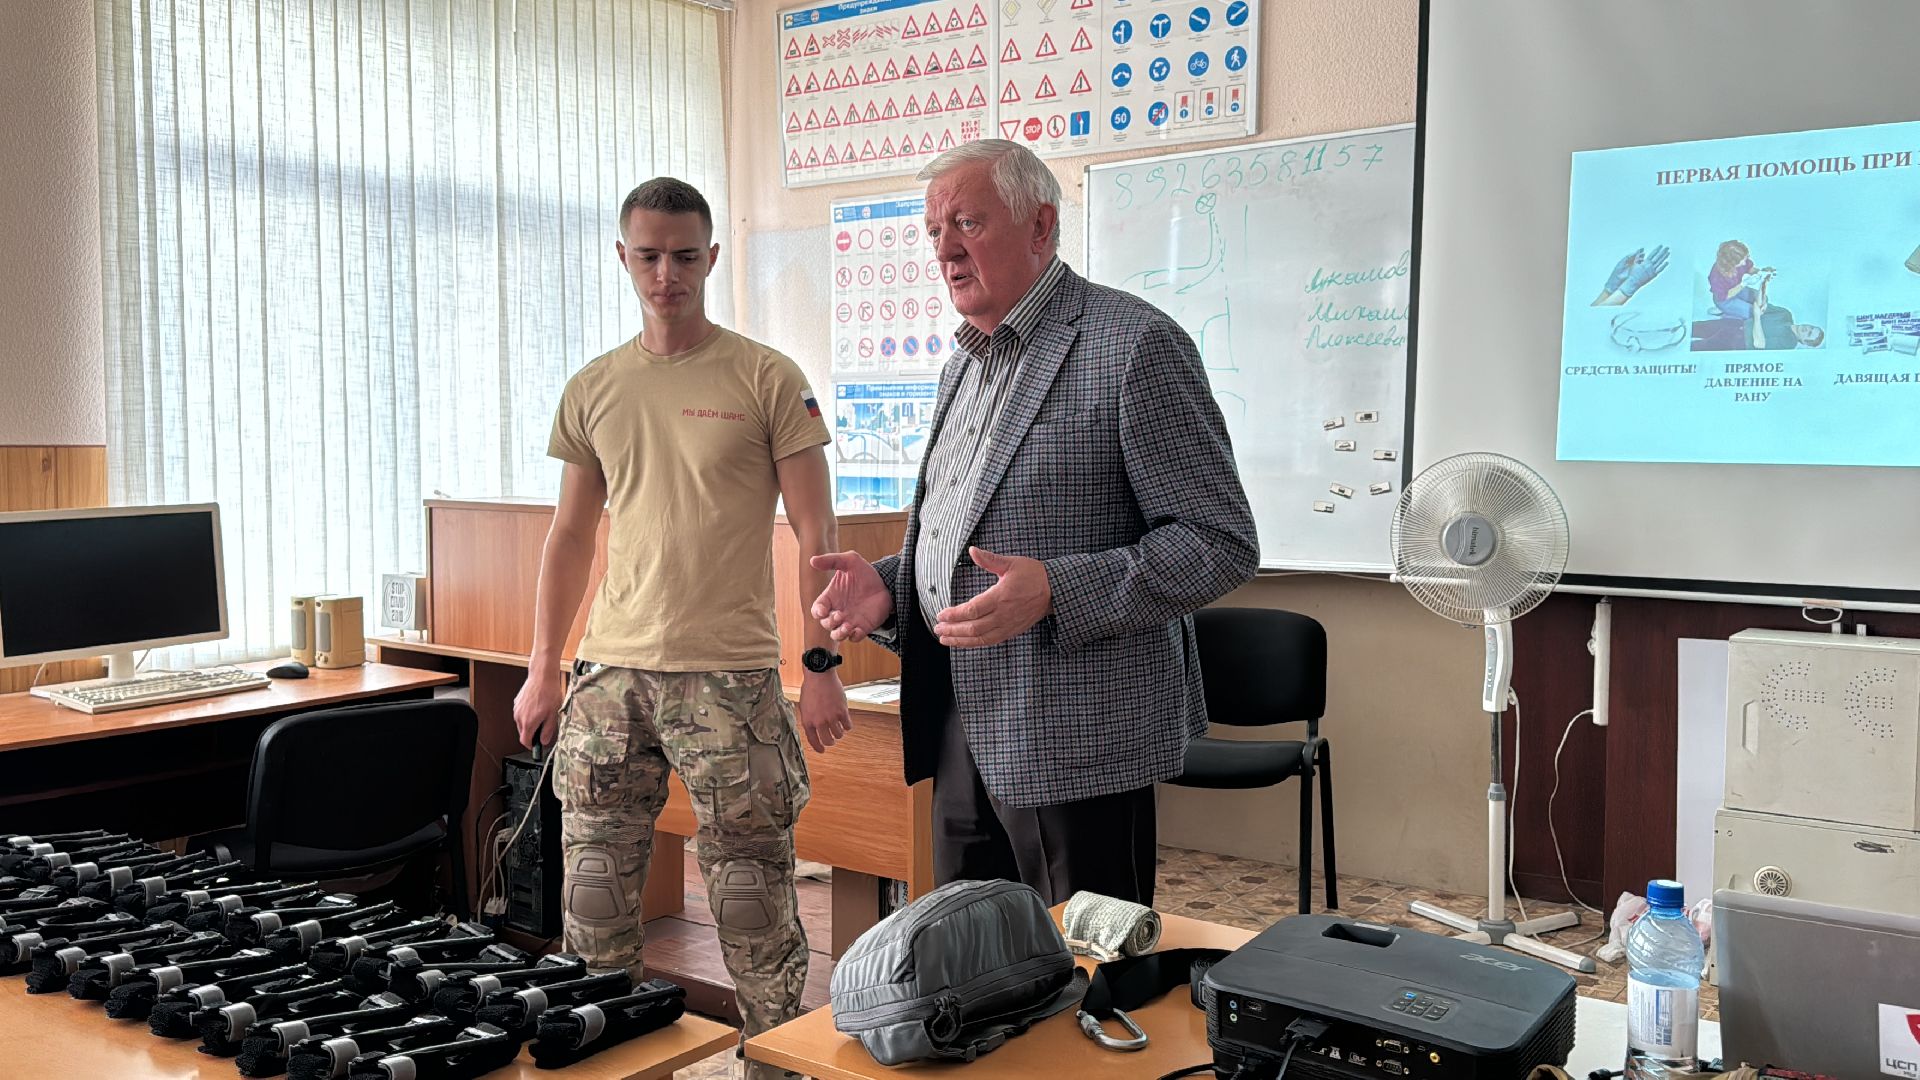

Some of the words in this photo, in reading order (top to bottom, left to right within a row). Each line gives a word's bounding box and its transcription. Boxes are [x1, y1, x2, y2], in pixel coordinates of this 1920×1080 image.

[1114, 114, 1127, 125] 50
[1025, 124, 1042, 135] STOP
[1656, 165, 1741, 185] ПЕРВАЯ
[1746, 156, 1856, 179] ПОМОЩЬ
[1862, 151, 1912, 170] ПРИ
[1565, 365, 1630, 376] СРЕДСТВА
[1633, 364, 1697, 376] ЗАЩИТЫ!
[1725, 362, 1784, 373] ПРЯМОЕ
[1704, 377, 1780, 389] ДАВЛЕНИЕ
[1783, 377, 1803, 387] НА
[1833, 373, 1911, 385] ДАВЯЩАЯ
[1735, 392, 1772, 402] РАНУ
[682, 409, 695, 417] МЫ
[697, 408, 719, 418] ДАЁМ
[720, 411, 745, 421] ШАНС
[1459, 953, 1534, 971] acer
[1886, 1057, 1918, 1071] ЦСП
